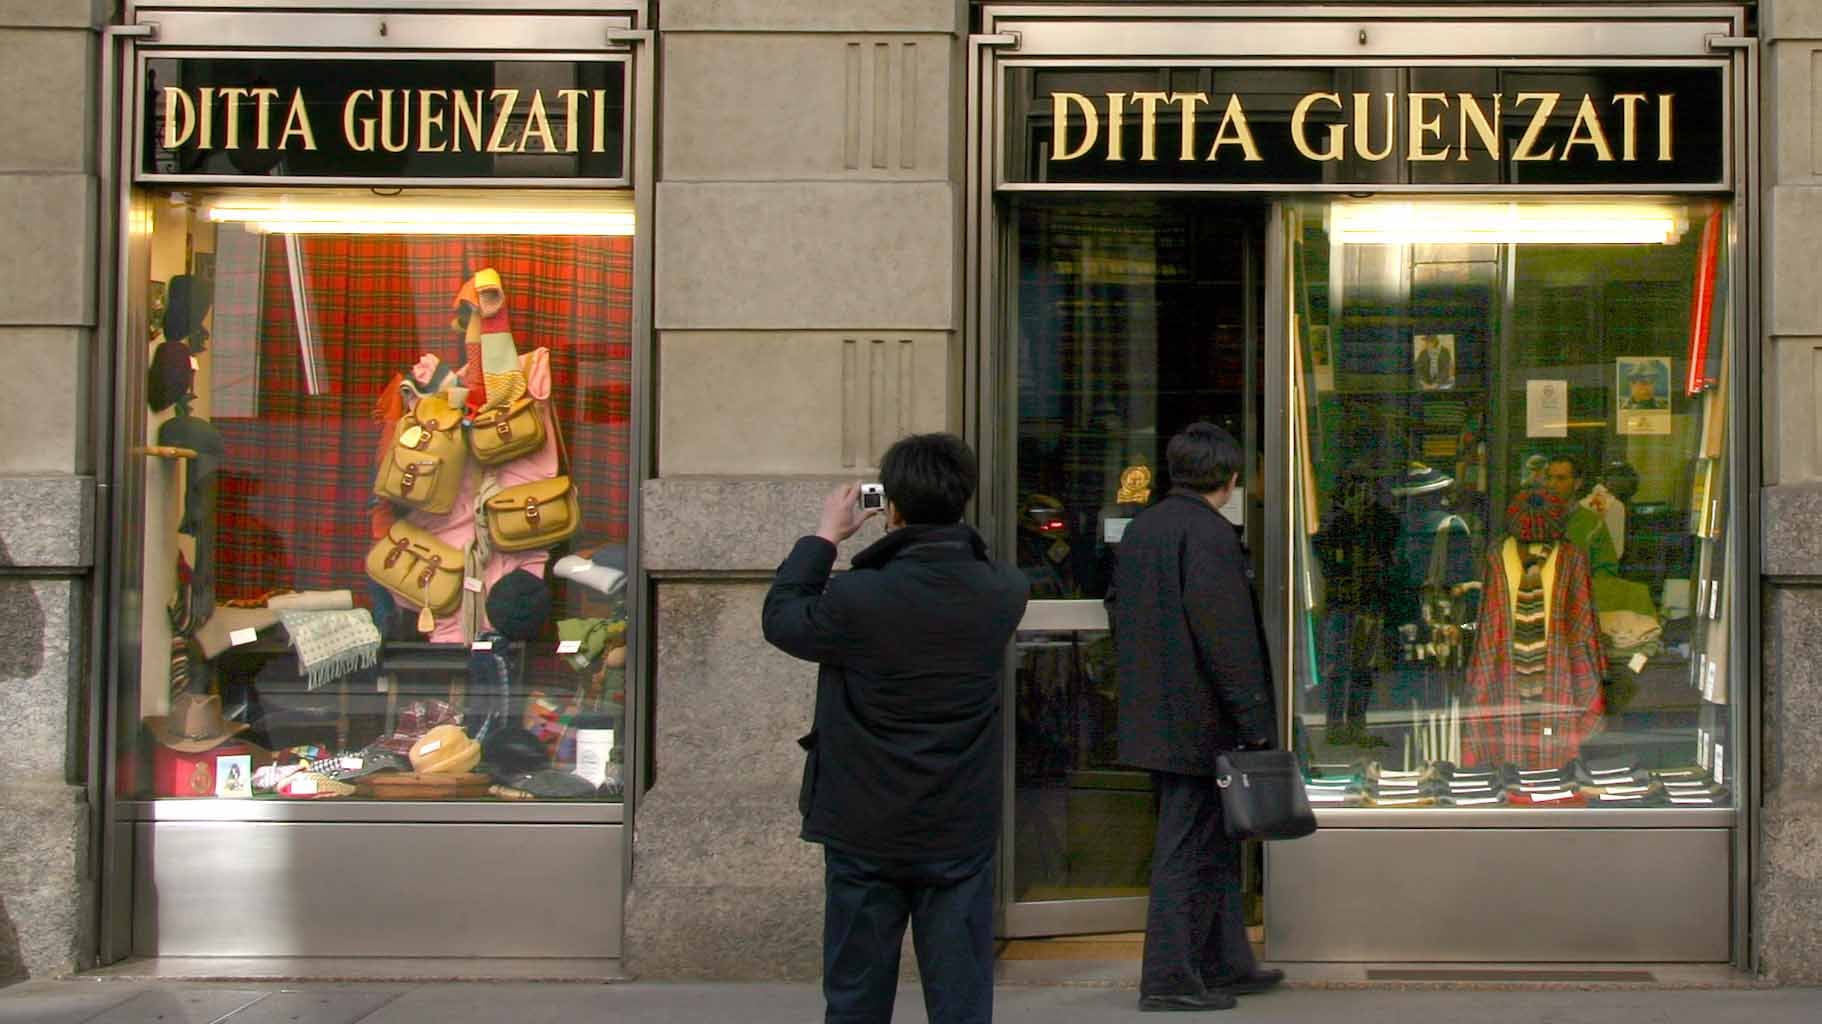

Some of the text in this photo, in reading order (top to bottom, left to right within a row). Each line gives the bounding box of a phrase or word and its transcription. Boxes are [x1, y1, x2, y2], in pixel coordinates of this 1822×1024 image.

[163, 86, 607, 154] DITTA GUENZATI
[1050, 91, 1675, 162] DITTA GUENZATI
